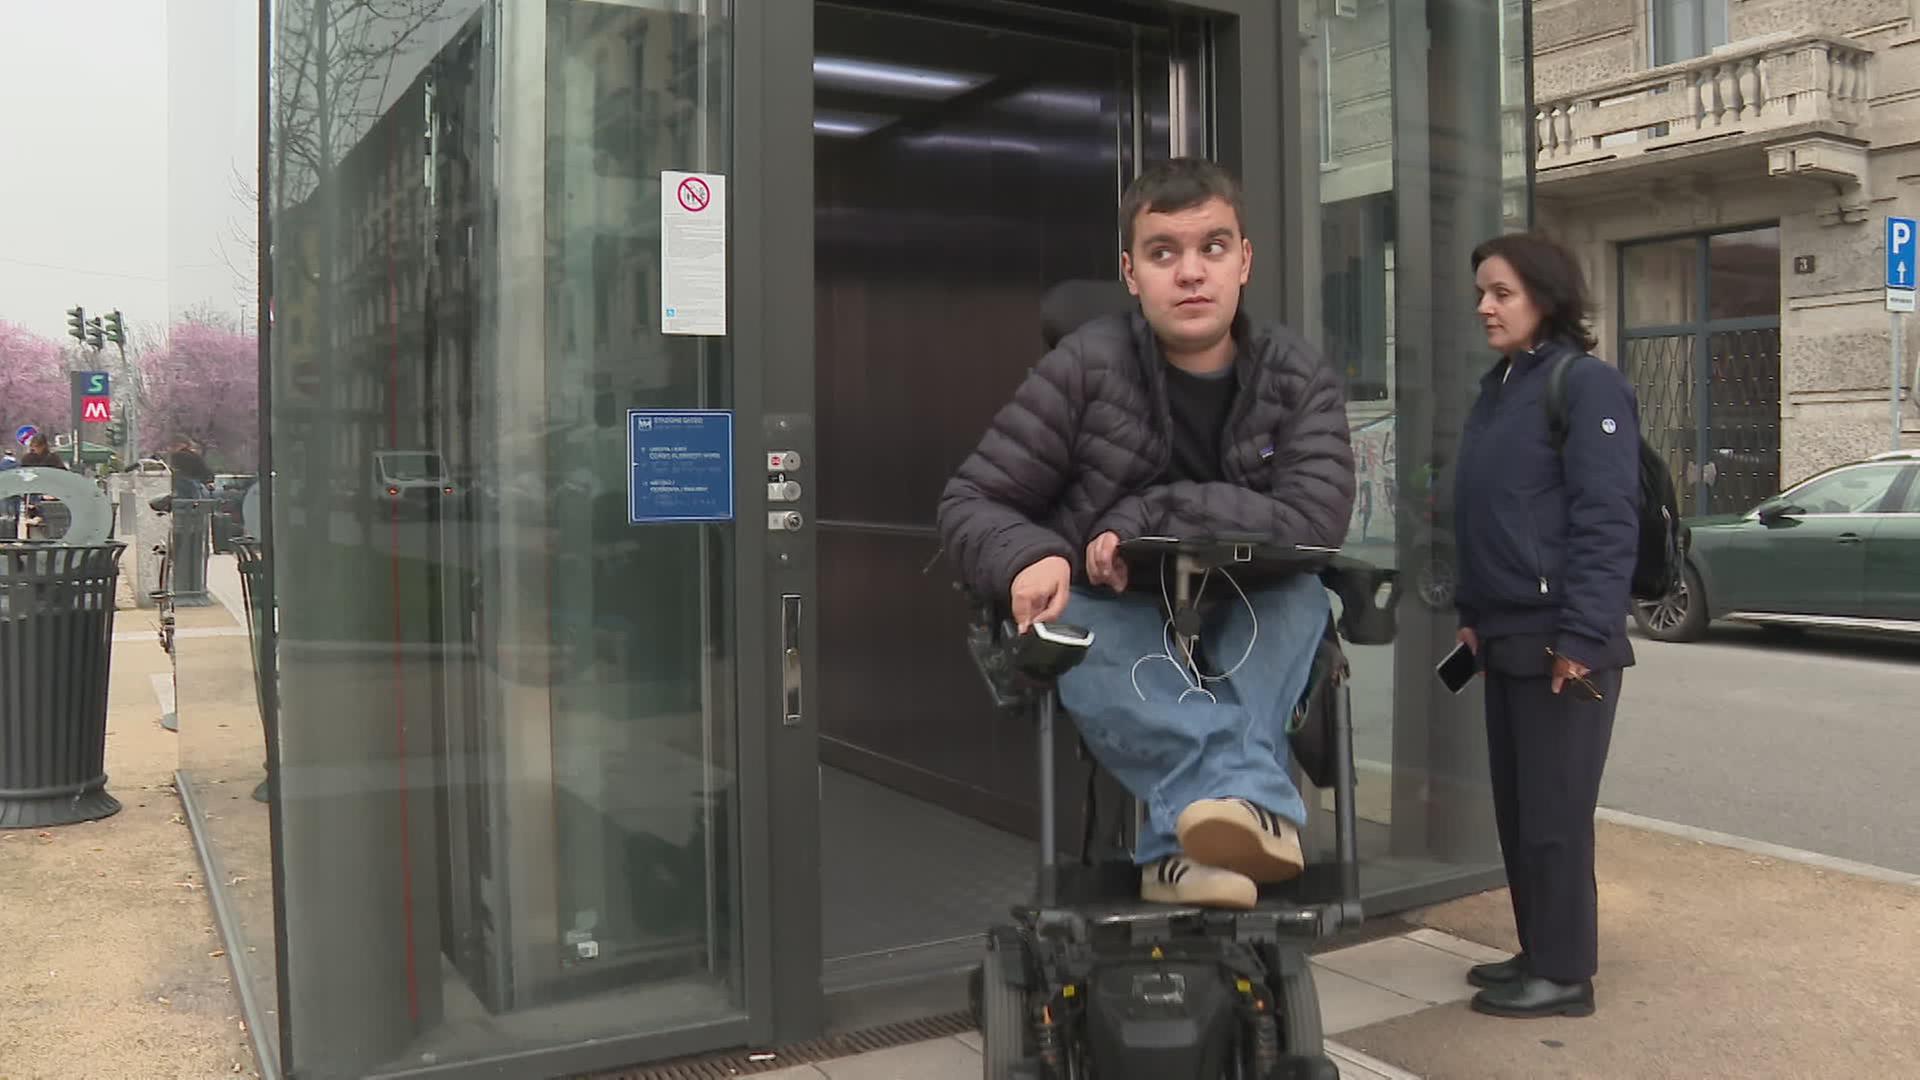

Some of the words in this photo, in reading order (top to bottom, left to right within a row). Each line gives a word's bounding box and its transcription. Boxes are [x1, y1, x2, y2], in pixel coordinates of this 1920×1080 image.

[1892, 222, 1911, 254] P
[88, 374, 104, 392] S
[84, 402, 108, 418] M
